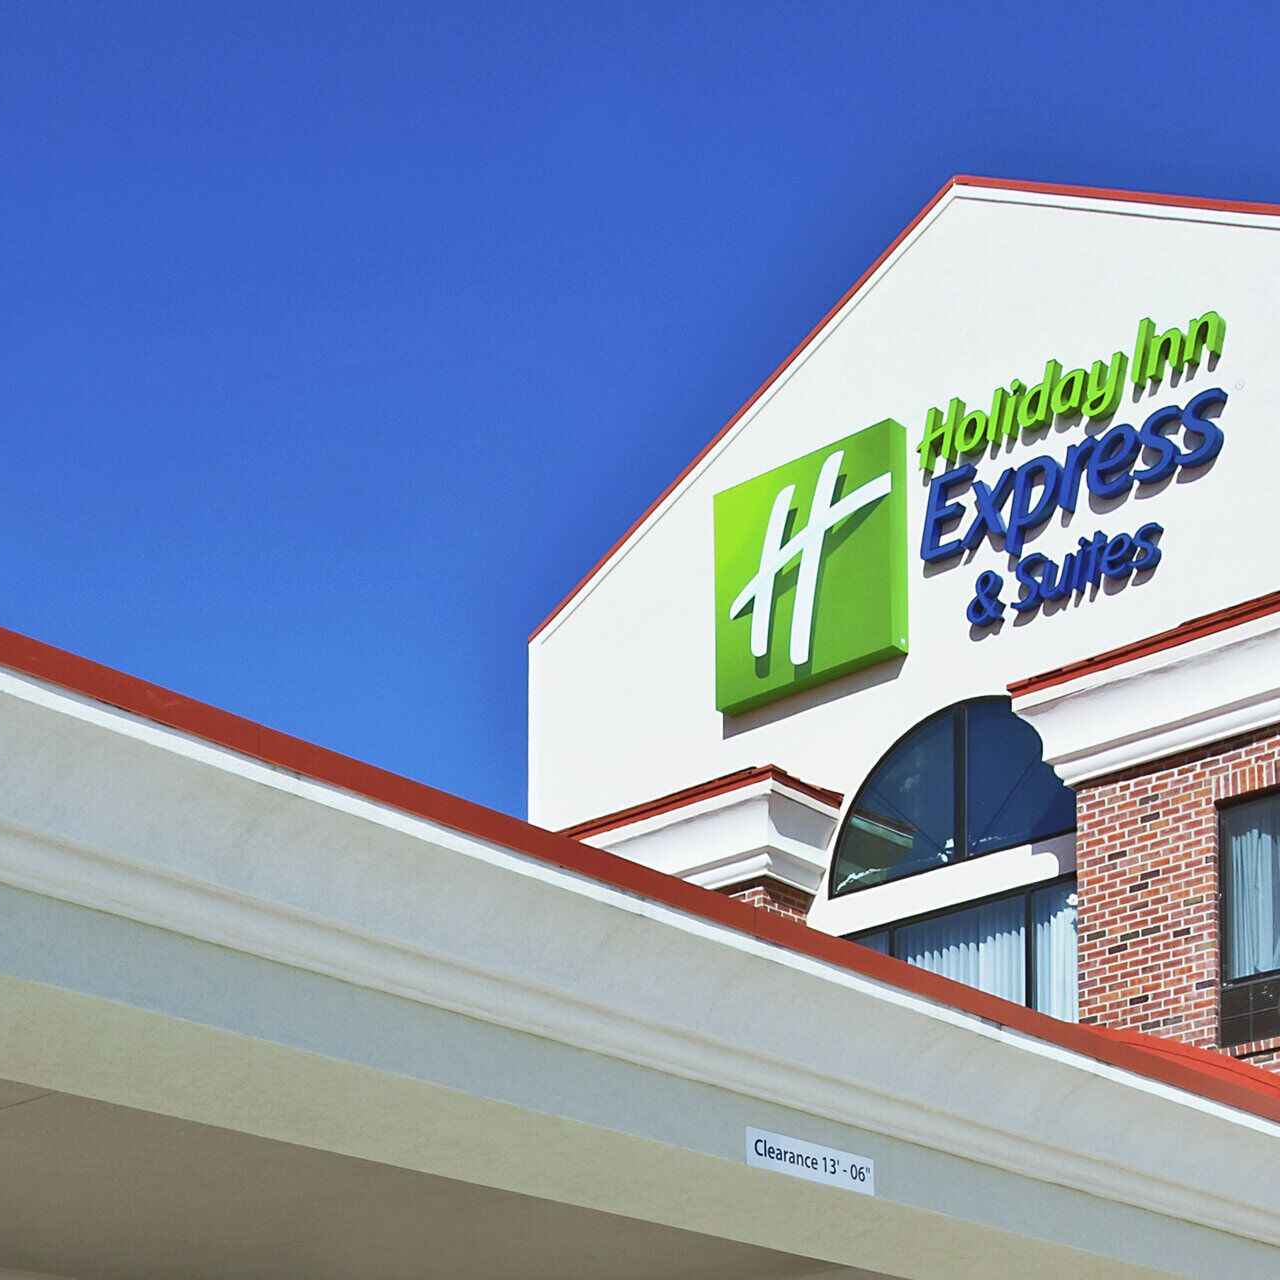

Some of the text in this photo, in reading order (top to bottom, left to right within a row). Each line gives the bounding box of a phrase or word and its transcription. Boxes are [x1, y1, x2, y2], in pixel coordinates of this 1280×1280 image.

[916, 311, 1227, 472] Holiday Inn
[920, 387, 1228, 564] Express
[966, 522, 1164, 627] & Suites
[754, 1139, 818, 1170] Clearance
[822, 1157, 840, 1175] 13'
[850, 1163, 871, 1182] 06"
